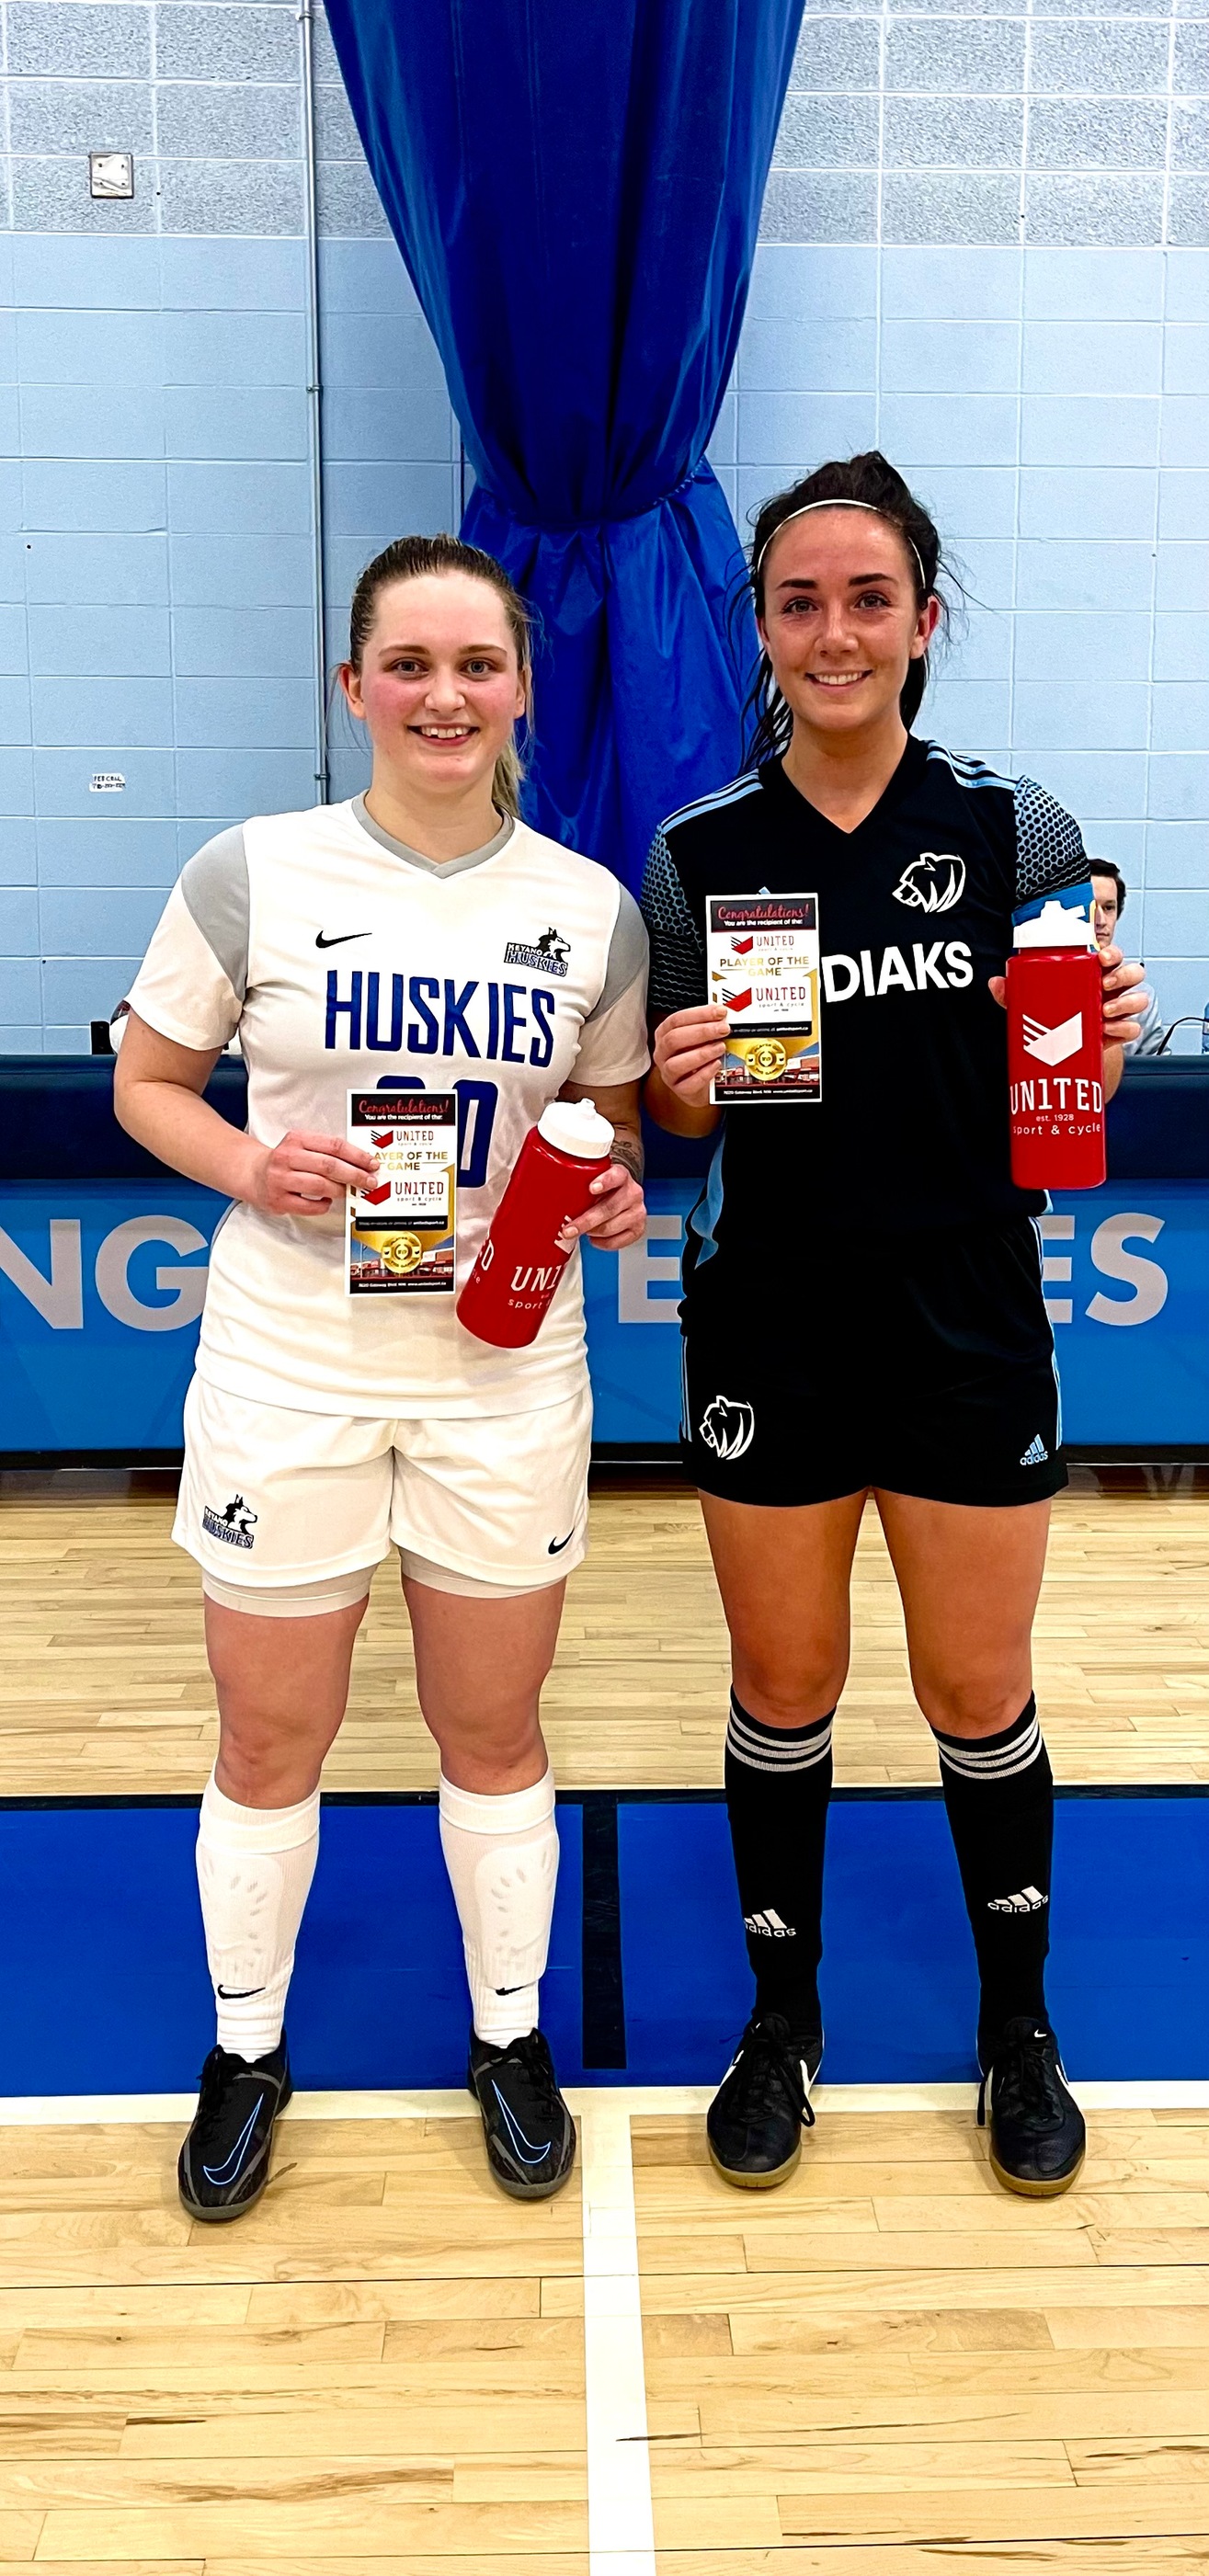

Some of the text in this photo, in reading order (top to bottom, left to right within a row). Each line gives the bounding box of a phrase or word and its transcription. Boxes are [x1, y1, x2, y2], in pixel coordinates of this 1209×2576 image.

[718, 904, 809, 921] Congratulations!
[758, 918, 783, 927] recipient
[508, 943, 542, 956] KEYANO
[505, 950, 568, 976] HUSKIES
[720, 956, 810, 968] PLAYER OF THE
[748, 967, 781, 976] GAME
[821, 941, 974, 1002] DIAKS
[325, 970, 555, 1067] HUSKIES
[359, 1099, 449, 1115] Congratulations!
[1054, 1113, 1075, 1122] 1928
[1012, 1123, 1101, 1136] sport & cycle
[373, 1151, 448, 1160] AYER OF THE
[387, 1162, 420, 1170] GAME
[508, 1298, 542, 1310] sport
[1020, 1451, 1048, 1466] adidas
[987, 1895, 1048, 1913] adidas
